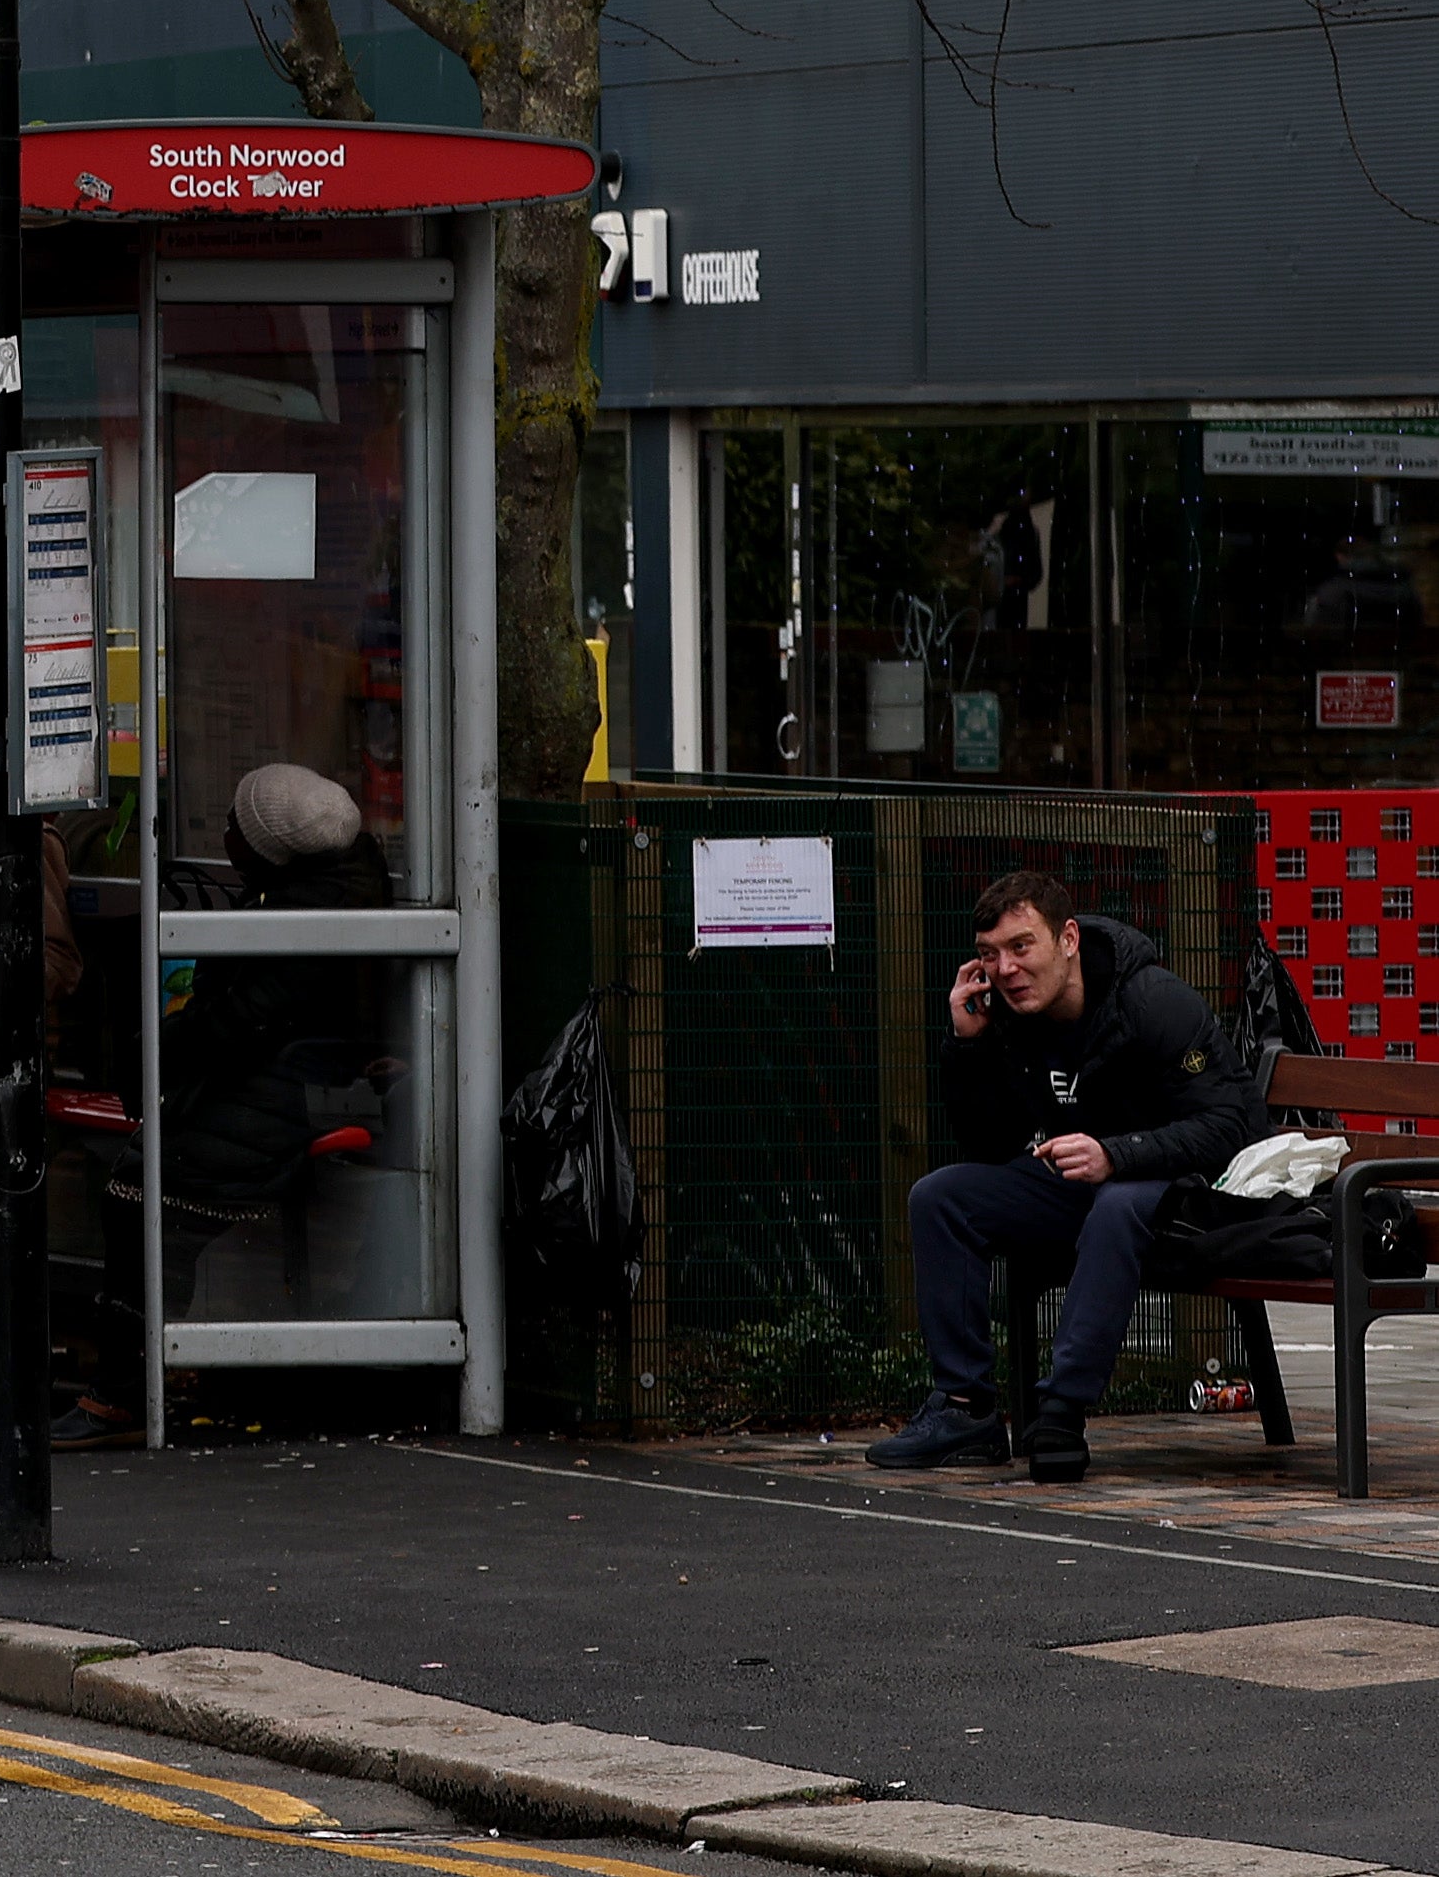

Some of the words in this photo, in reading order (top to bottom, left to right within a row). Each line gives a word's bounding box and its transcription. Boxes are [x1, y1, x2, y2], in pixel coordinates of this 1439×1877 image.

[149, 145, 222, 168] South
[230, 145, 345, 168] Norwood
[170, 175, 240, 198] Clock
[247, 173, 323, 198] Twer
[682, 249, 761, 305] COFFEEHOUSE
[29, 480, 42, 492] 410
[28, 653, 38, 665] 75
